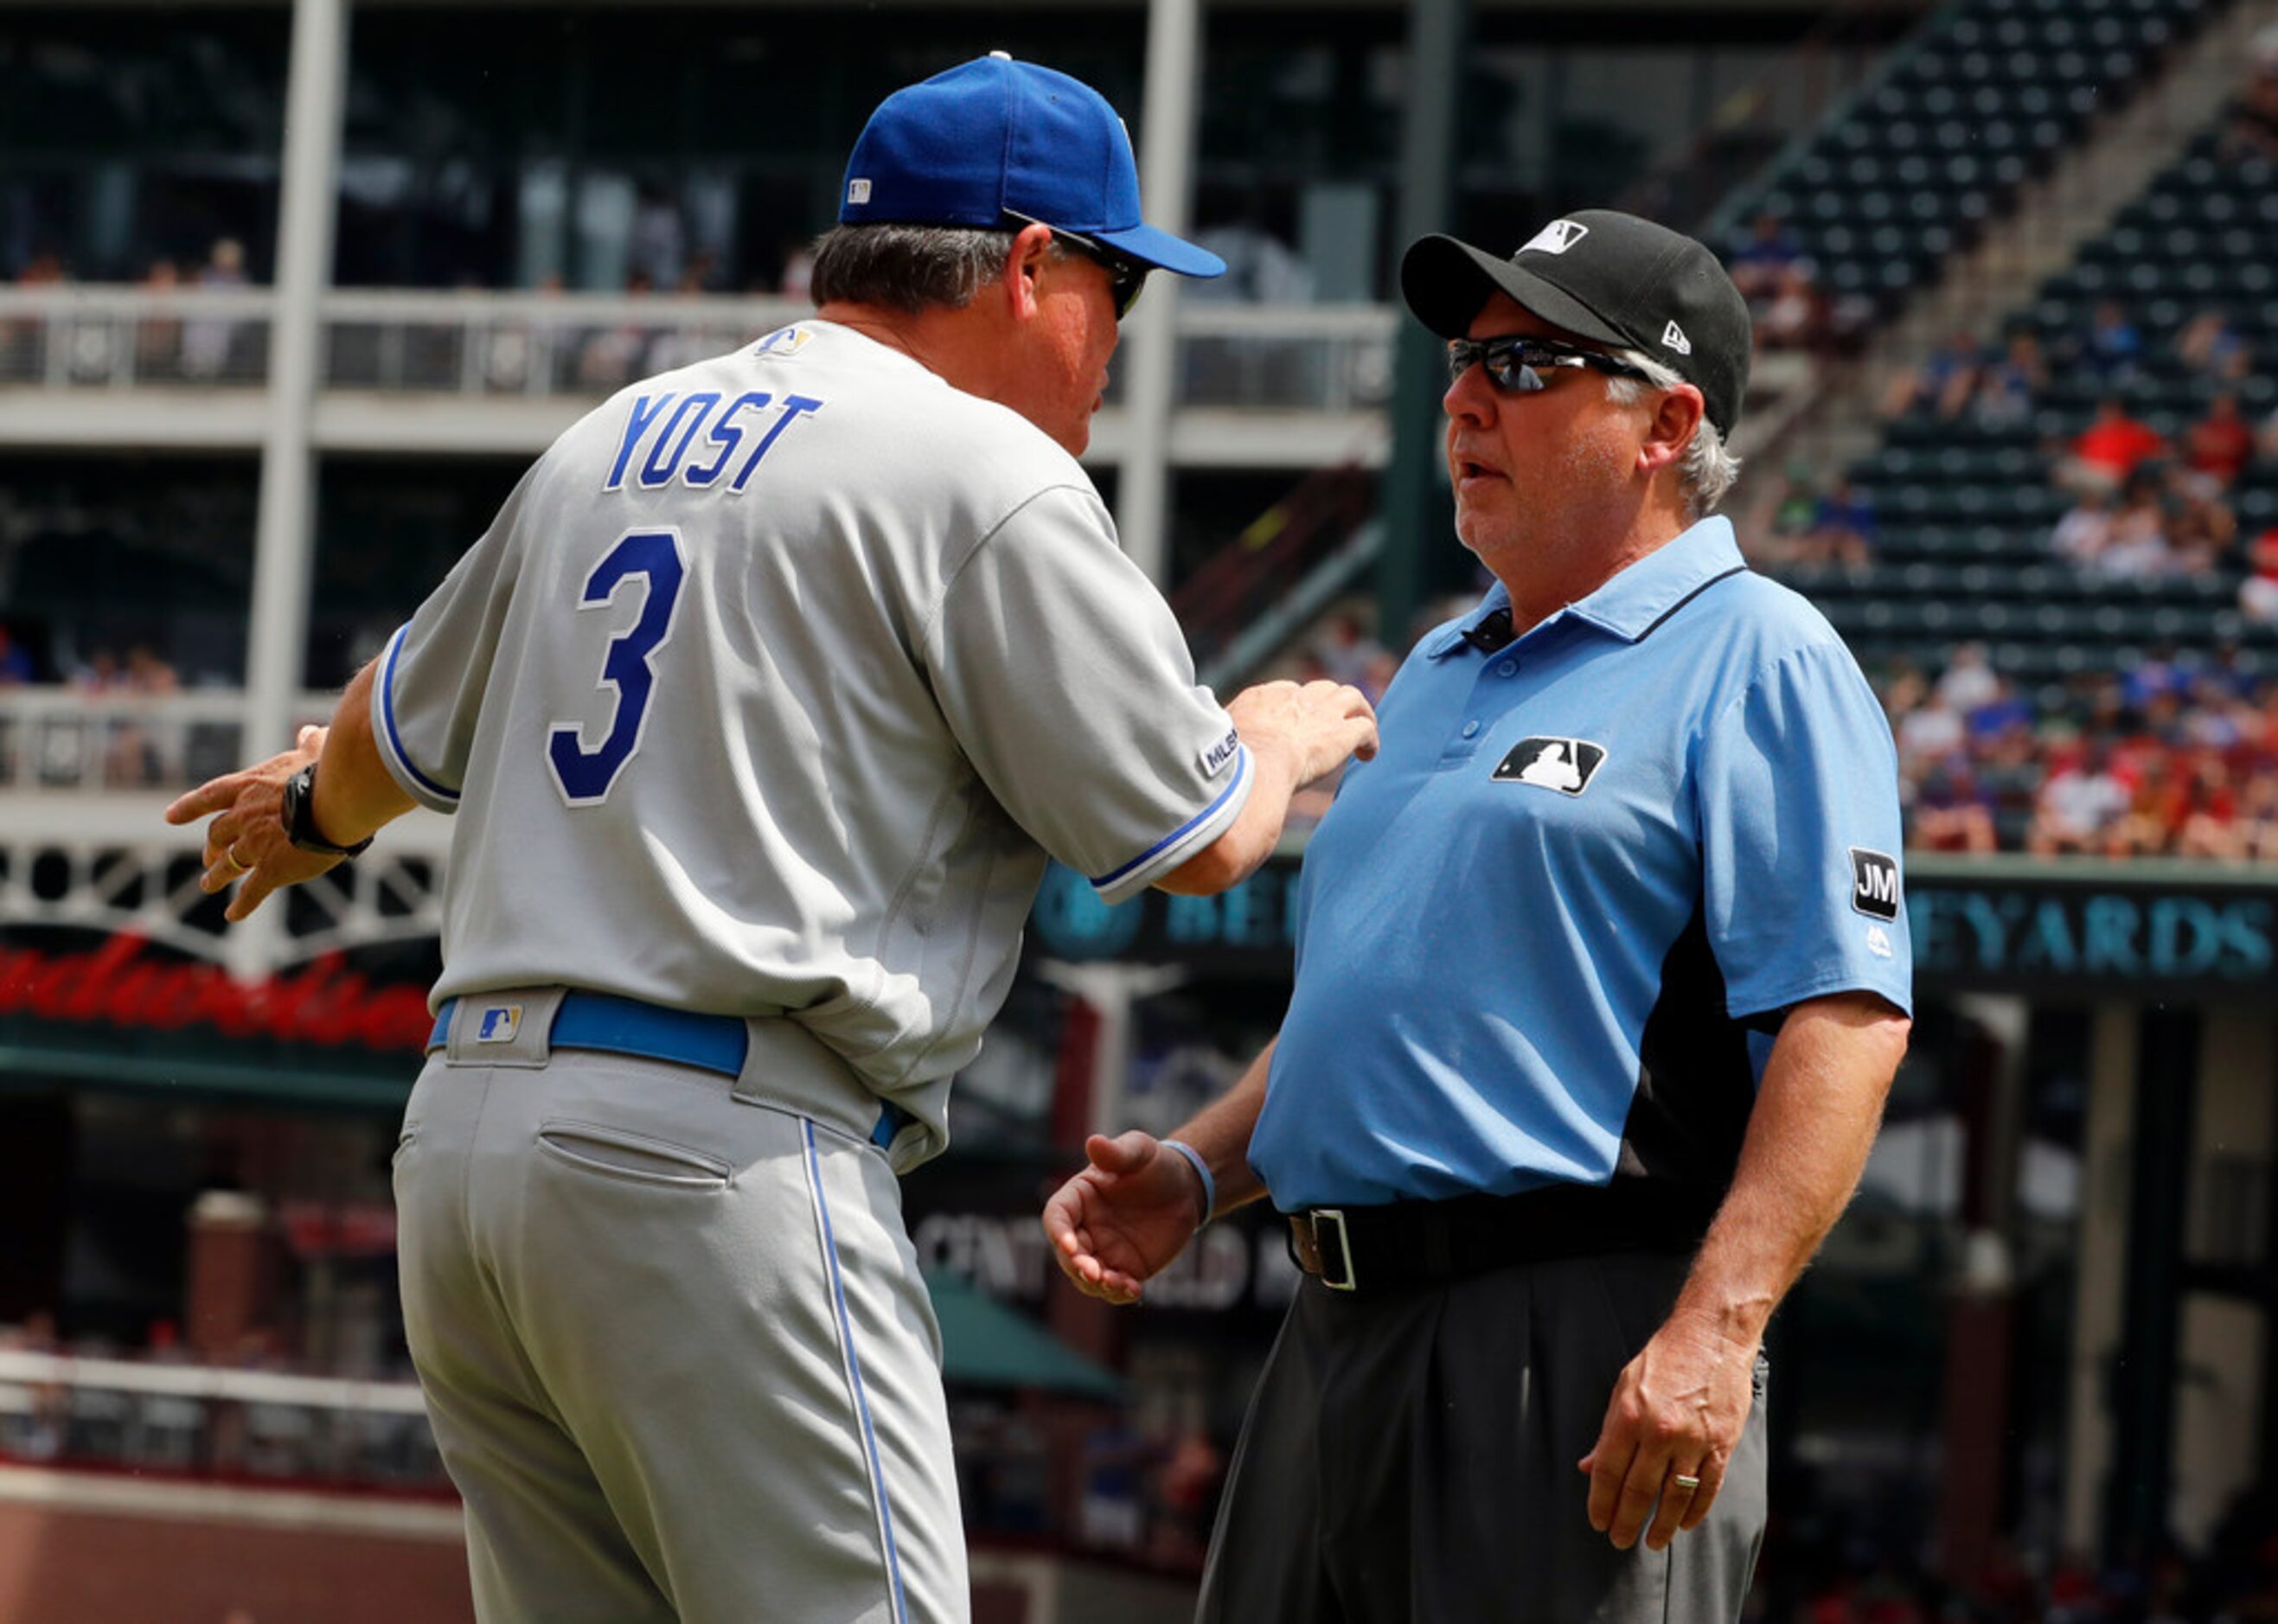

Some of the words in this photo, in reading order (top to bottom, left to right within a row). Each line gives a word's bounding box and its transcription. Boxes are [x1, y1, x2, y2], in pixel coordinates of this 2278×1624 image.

[603, 391, 823, 494] YOST
[546, 527, 690, 808] 3
[1858, 862, 1897, 905] JM
